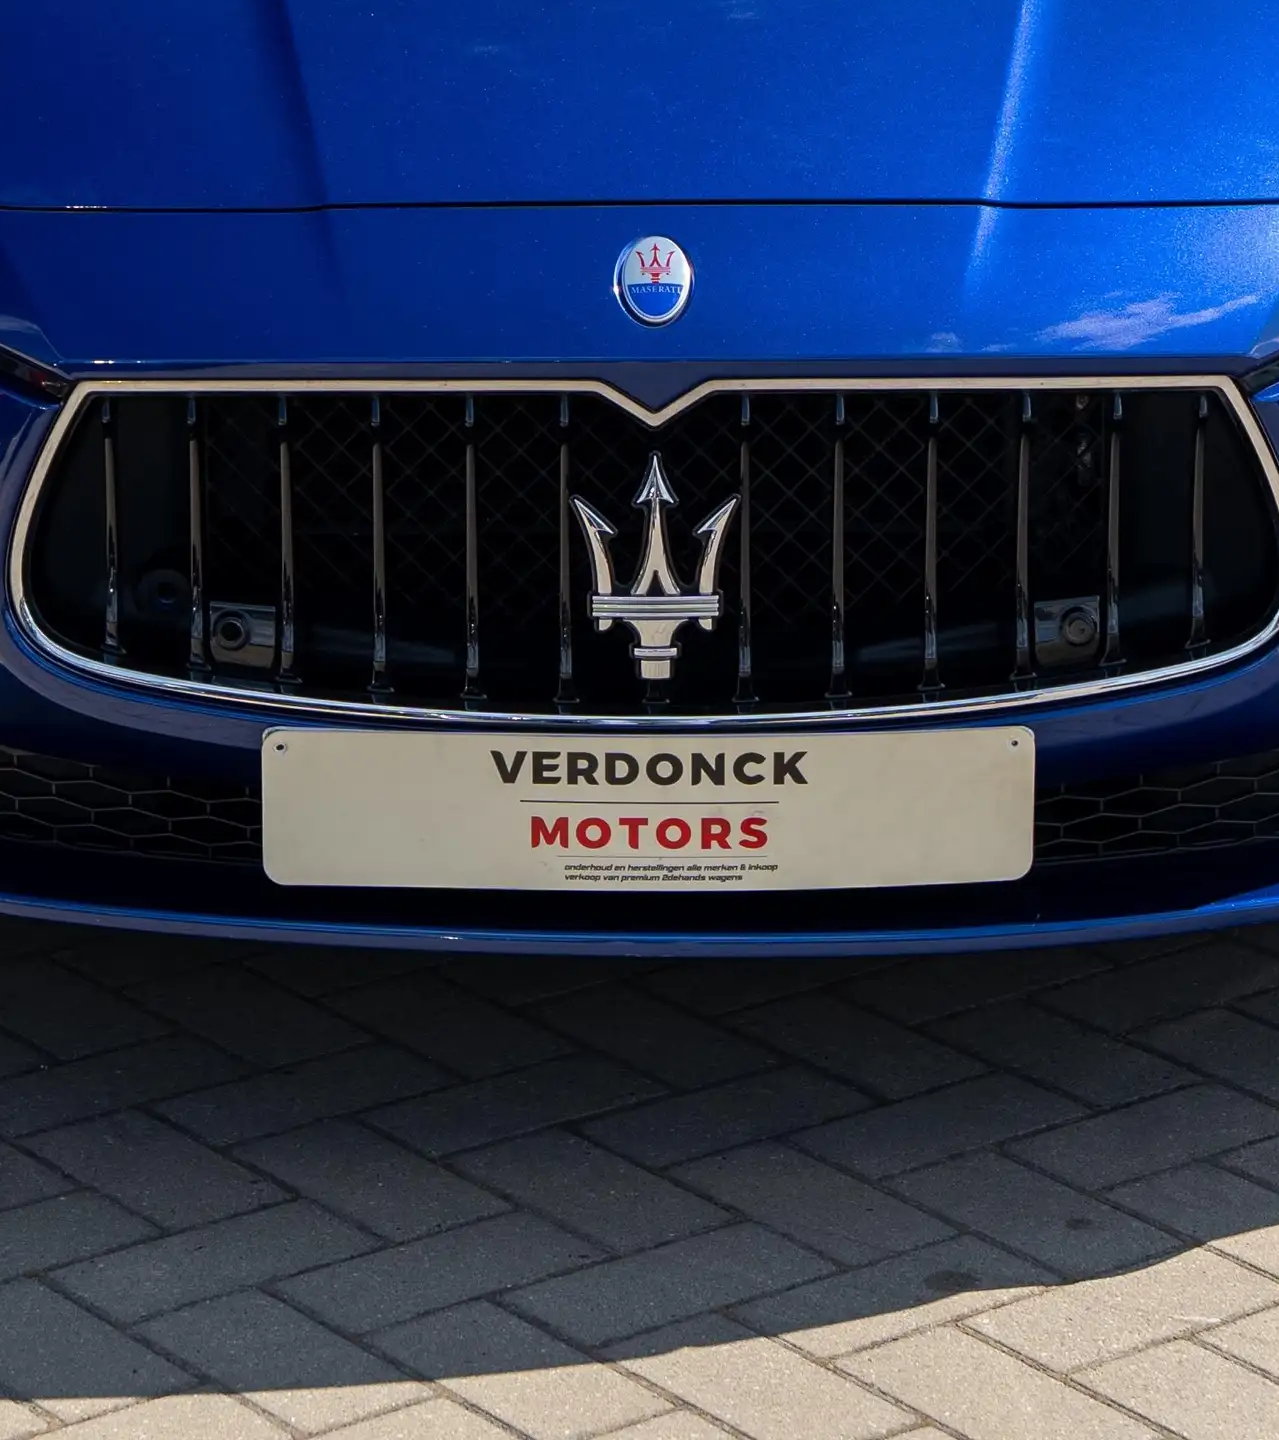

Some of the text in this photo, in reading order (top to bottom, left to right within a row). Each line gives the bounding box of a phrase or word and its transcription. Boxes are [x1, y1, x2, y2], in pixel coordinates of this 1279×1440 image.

[631, 285, 681, 294] MASERATI
[490, 750, 808, 786] VERDONCK
[531, 816, 768, 850] MOTORS
[564, 863, 613, 871] onderhoud
[627, 864, 684, 873] herstellingen
[748, 863, 778, 872] inkoop
[564, 873, 601, 882] verkoop
[621, 874, 660, 882] premium
[708, 875, 743, 883] wagens
